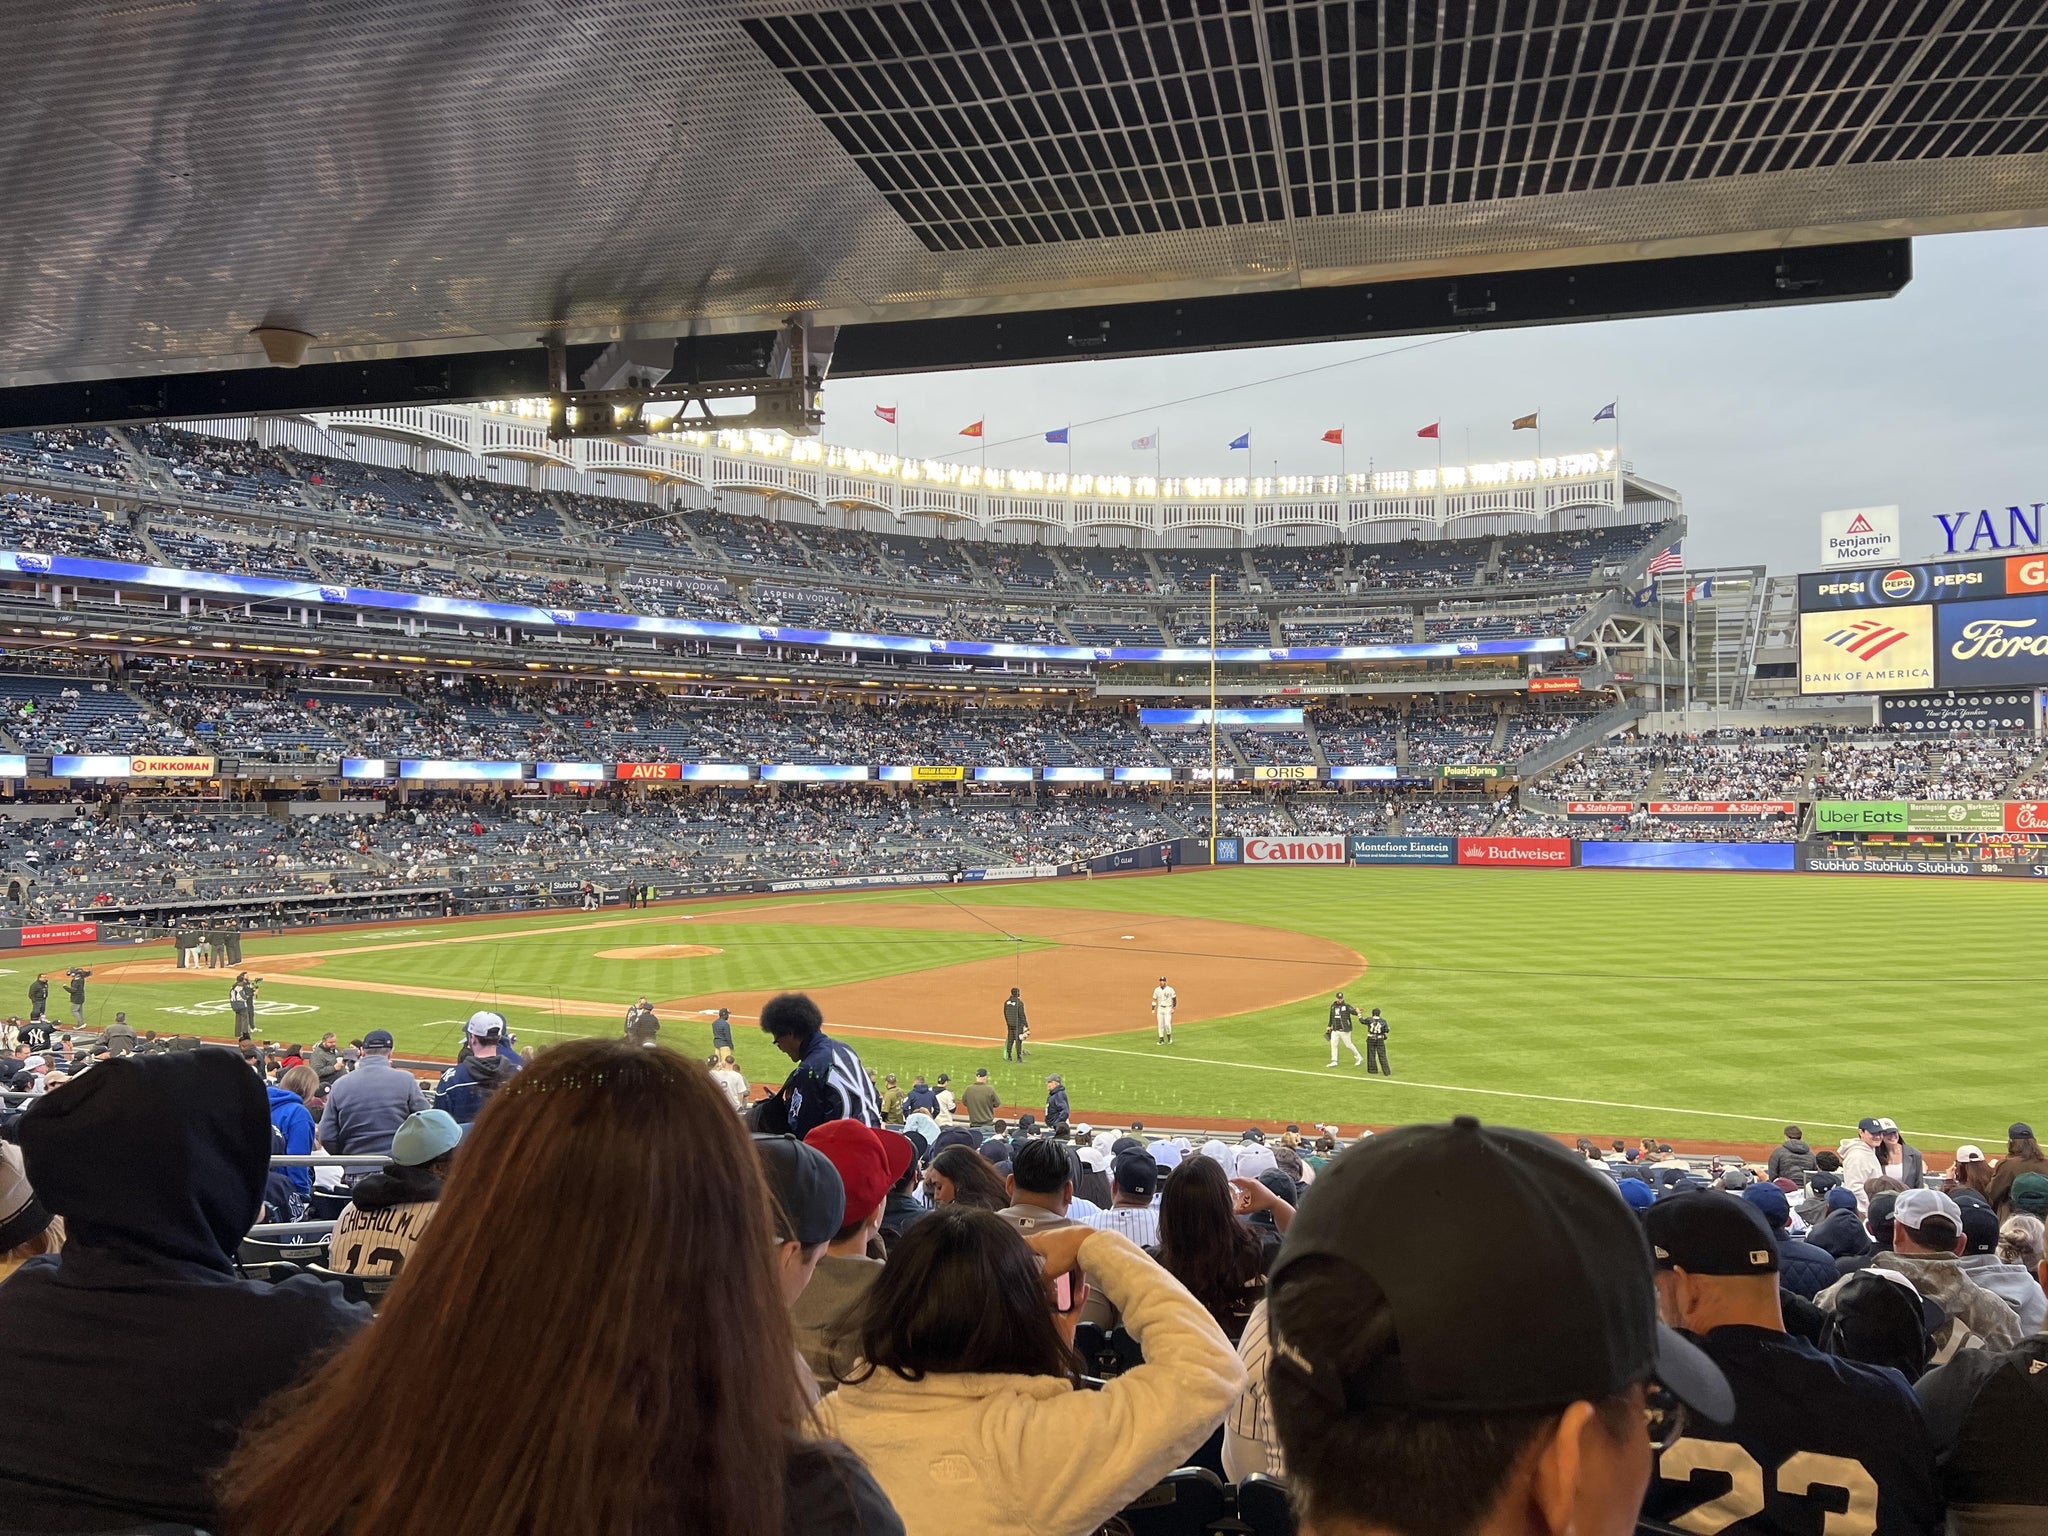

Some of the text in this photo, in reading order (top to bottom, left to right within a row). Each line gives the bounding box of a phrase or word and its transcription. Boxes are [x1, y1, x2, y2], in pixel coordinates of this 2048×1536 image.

[1829, 533, 1891, 551] Benjamin
[1837, 546, 1881, 559] Moore
[1933, 572, 1983, 587] PEPSI
[2019, 561, 2048, 586] G
[637, 577, 720, 592] ASPEN VODKA
[1819, 582, 1865, 596] PEPSI
[1884, 579, 1913, 589] PEPSI
[762, 590, 836, 604] ASPEN VODKA
[1805, 668, 1929, 682] BANK OF AMERICA
[1544, 681, 1577, 689] Budweiser
[1925, 708, 1988, 719] New York Yankees
[150, 762, 209, 771] KIKKOMAN
[632, 765, 666, 778] AVIS
[1266, 767, 1305, 778] ORIS
[1444, 766, 1498, 777] Poland Spring
[1216, 768, 1234, 780] PM
[1672, 804, 1714, 812] State Farm
[1740, 804, 1761, 812] State
[1981, 810, 2000, 818] Circle
[1820, 810, 1859, 823] Uber
[1863, 810, 1903, 823] Eats
[1979, 832, 2029, 844] Jersey
[1245, 839, 1343, 861] Canon
[1355, 841, 1449, 852] Montefiore Einstein
[1488, 846, 1564, 860] Budweiser
[1810, 860, 1969, 873] StubHub StubHub StubHub
[514, 884, 540, 892] Stubb
[554, 882, 578, 890] StubHub
[51, 930, 81, 938] AMERICA
[27, 1028, 46, 1045] NY
[340, 1208, 414, 1237] CHISHOLM
[1660, 1437, 1879, 1536] 23
